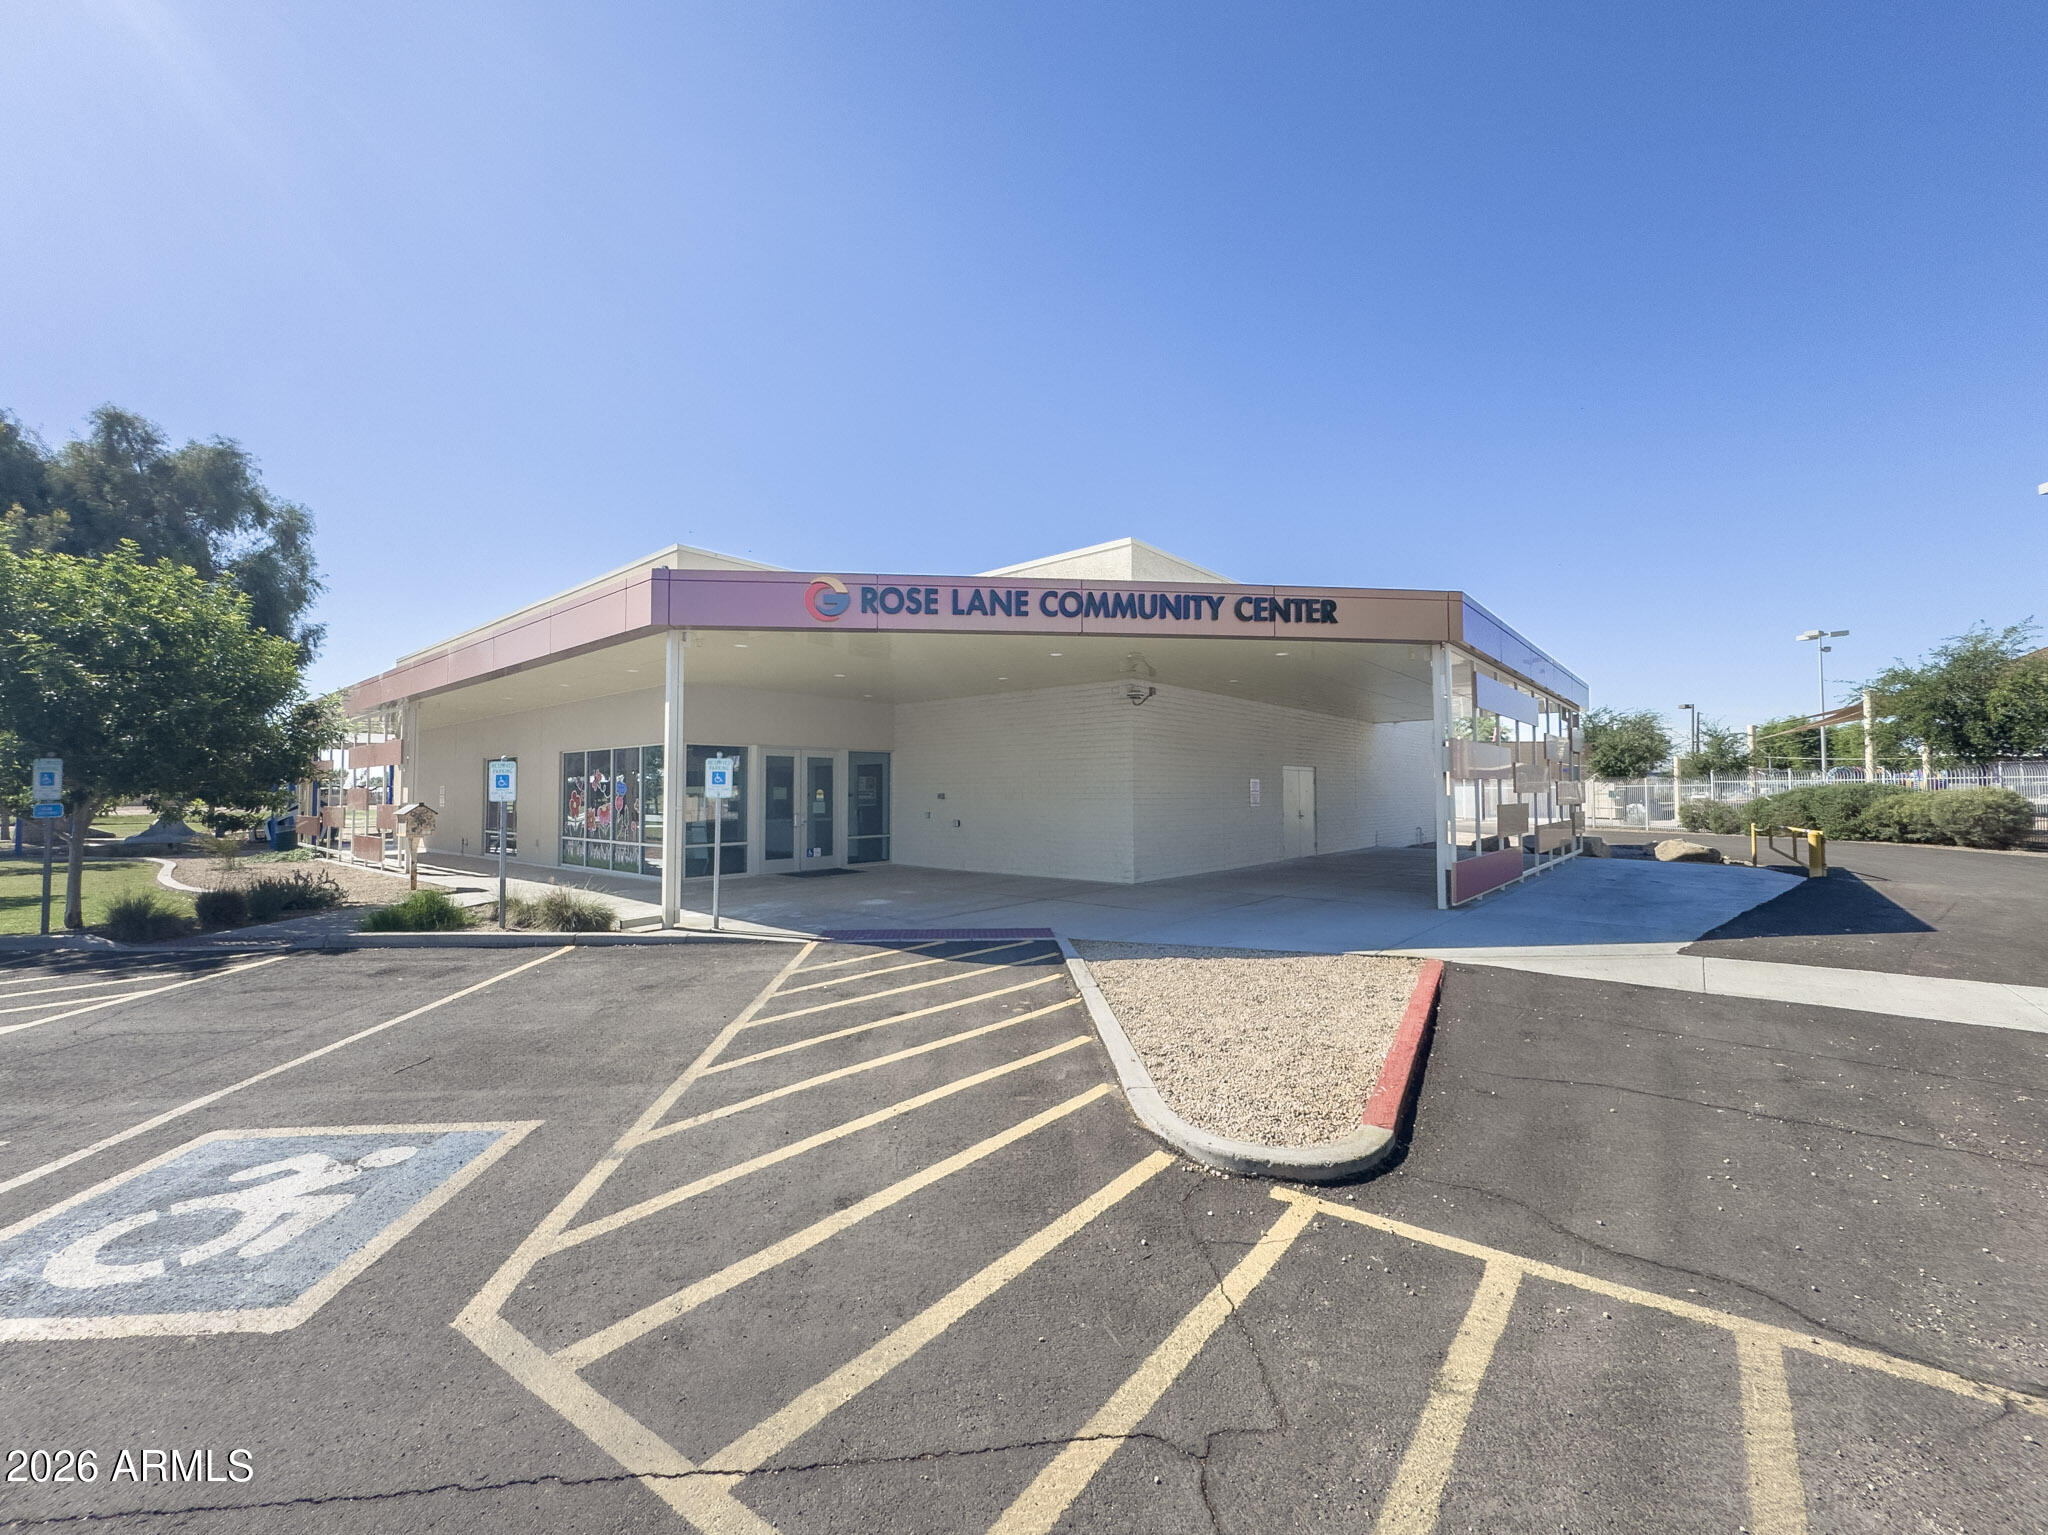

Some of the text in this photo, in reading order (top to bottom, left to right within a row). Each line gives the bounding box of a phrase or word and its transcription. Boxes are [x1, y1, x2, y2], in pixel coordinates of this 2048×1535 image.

[861, 586, 1338, 624] ROSE LANE COMMUNITY CENTER
